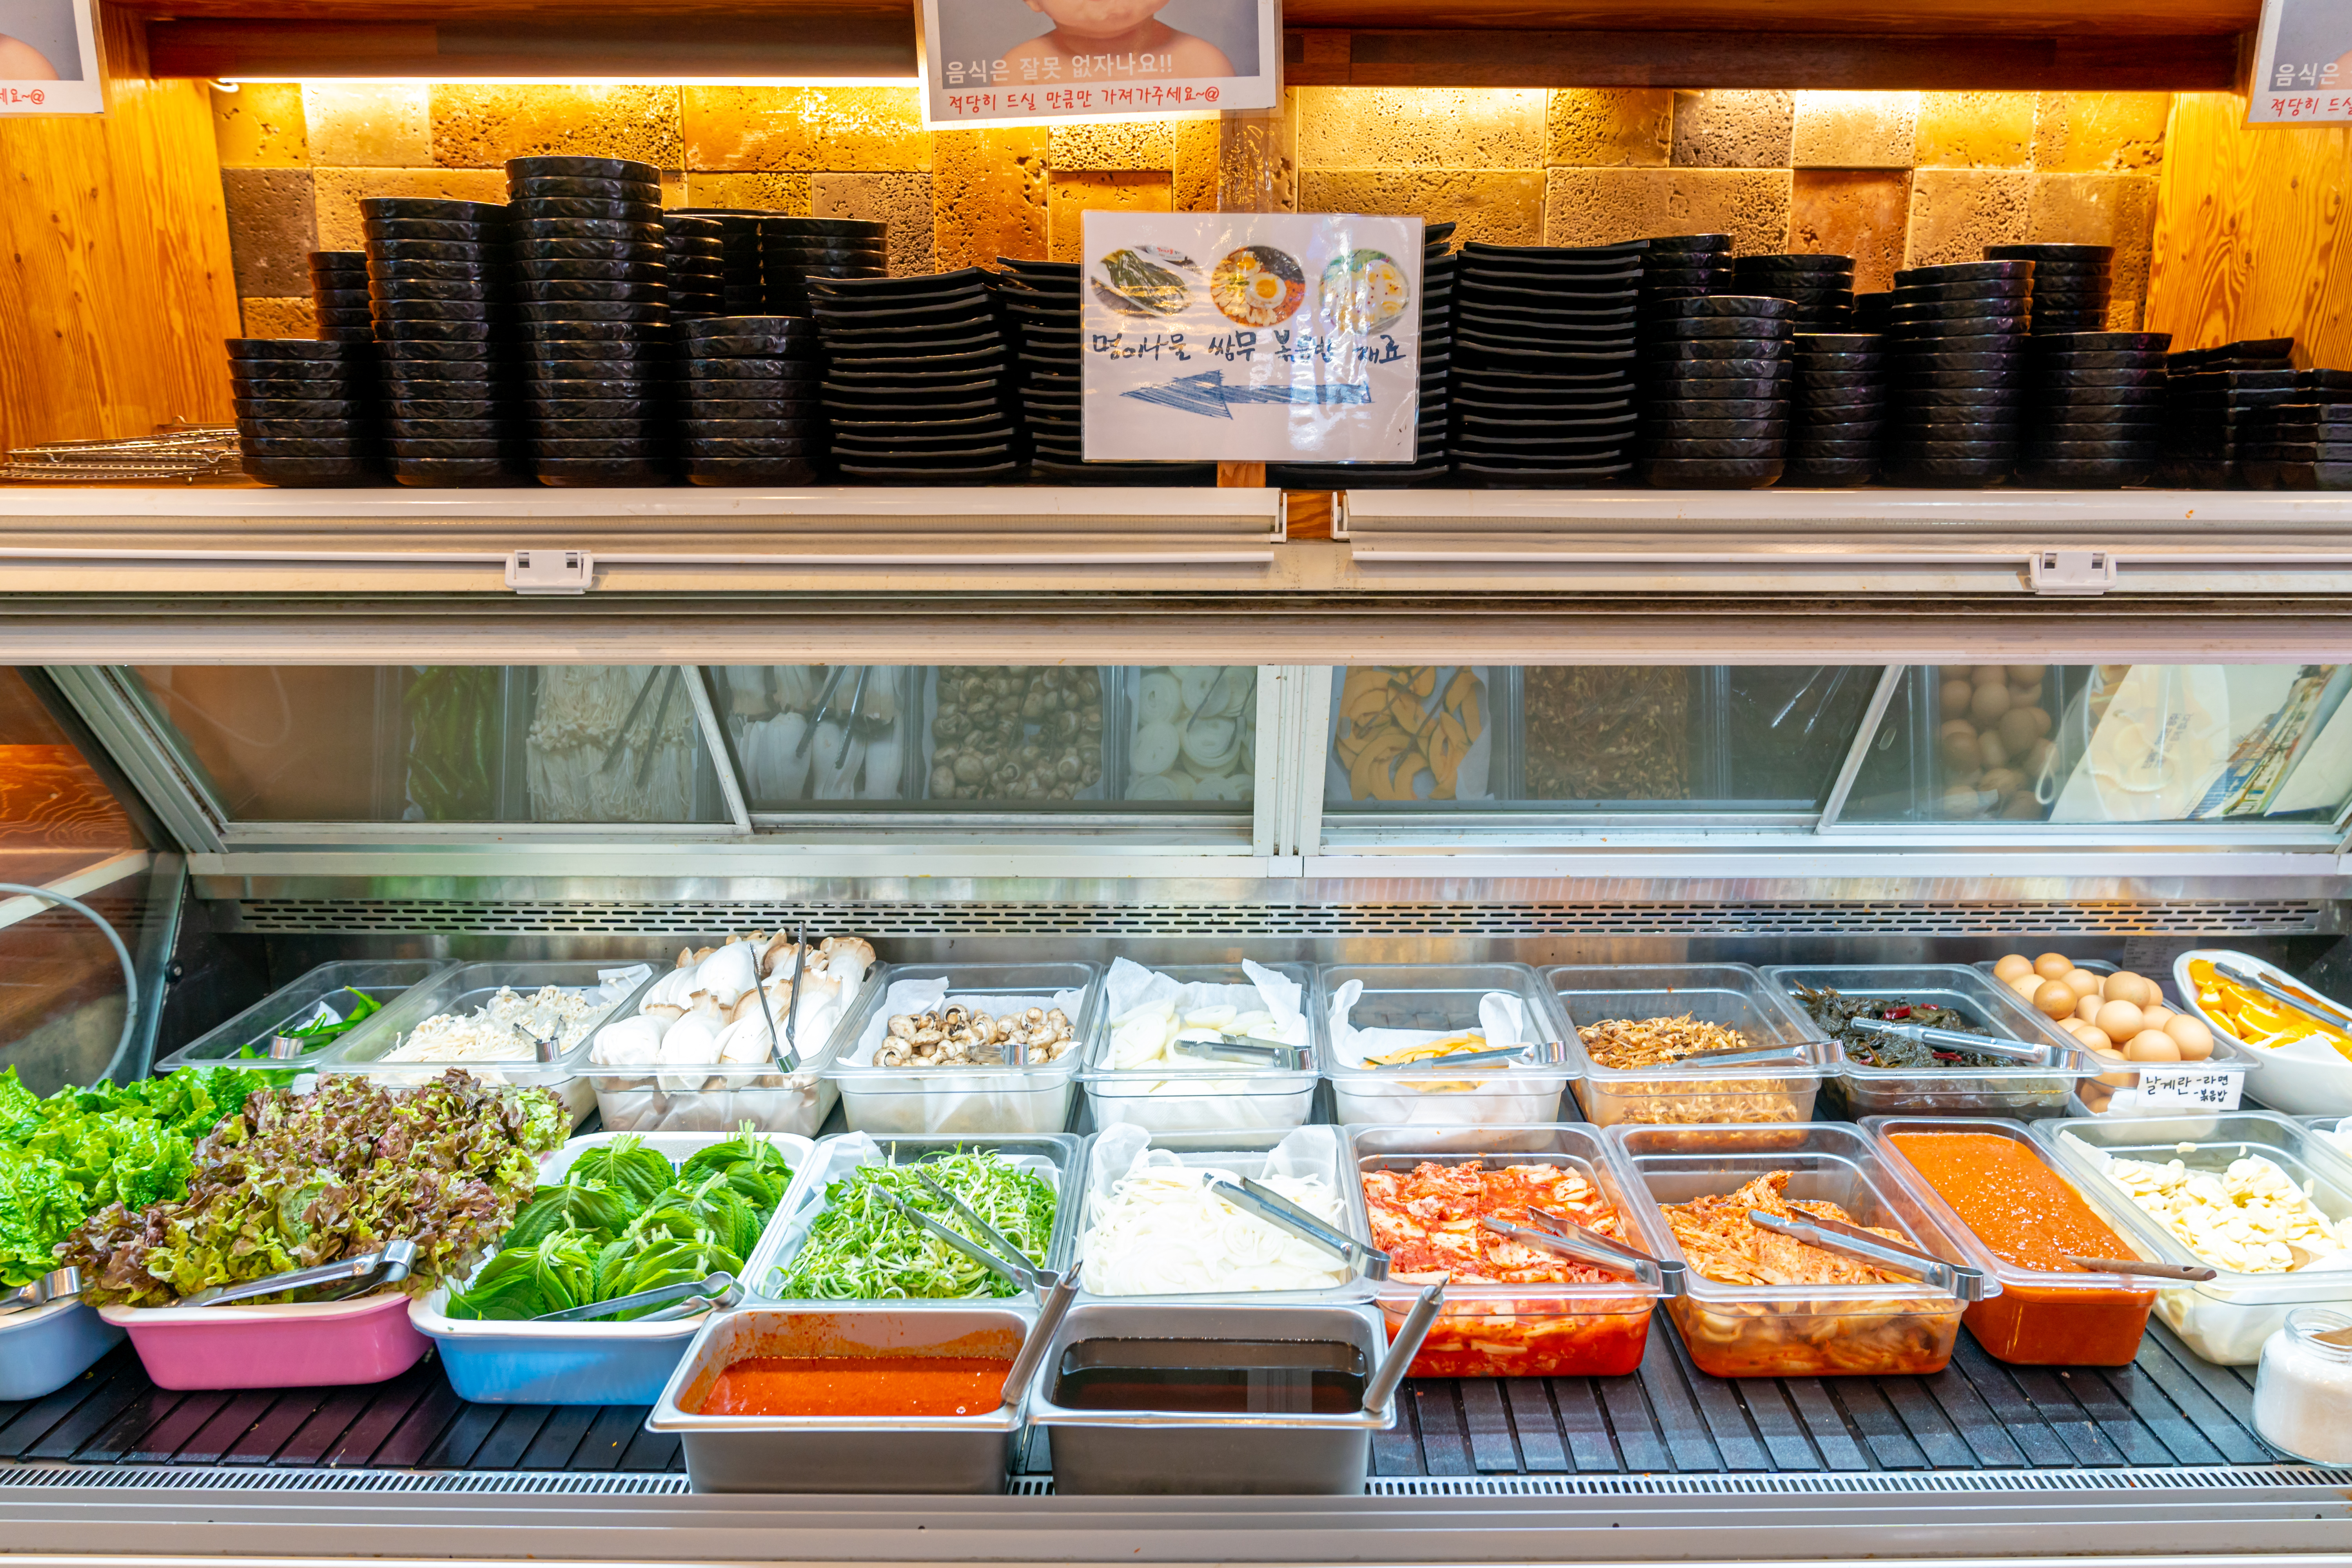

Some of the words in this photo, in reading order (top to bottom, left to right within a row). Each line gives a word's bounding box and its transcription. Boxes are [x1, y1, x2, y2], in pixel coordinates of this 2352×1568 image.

[946, 60, 1010, 83] 음식은
[1020, 57, 1062, 80] 잘못
[1072, 53, 1172, 78] 없자나요!!
[2275, 63, 2340, 86] 음식은
[949, 94, 996, 114] 적당히
[1007, 93, 1036, 111] 드실
[1046, 90, 1092, 109] 만큼만
[2271, 97, 2319, 117] 적당히
[1093, 332, 1191, 361] 명이나물
[1208, 330, 1256, 361] 쌈무
[2146, 1076, 2192, 1095] 날계란
